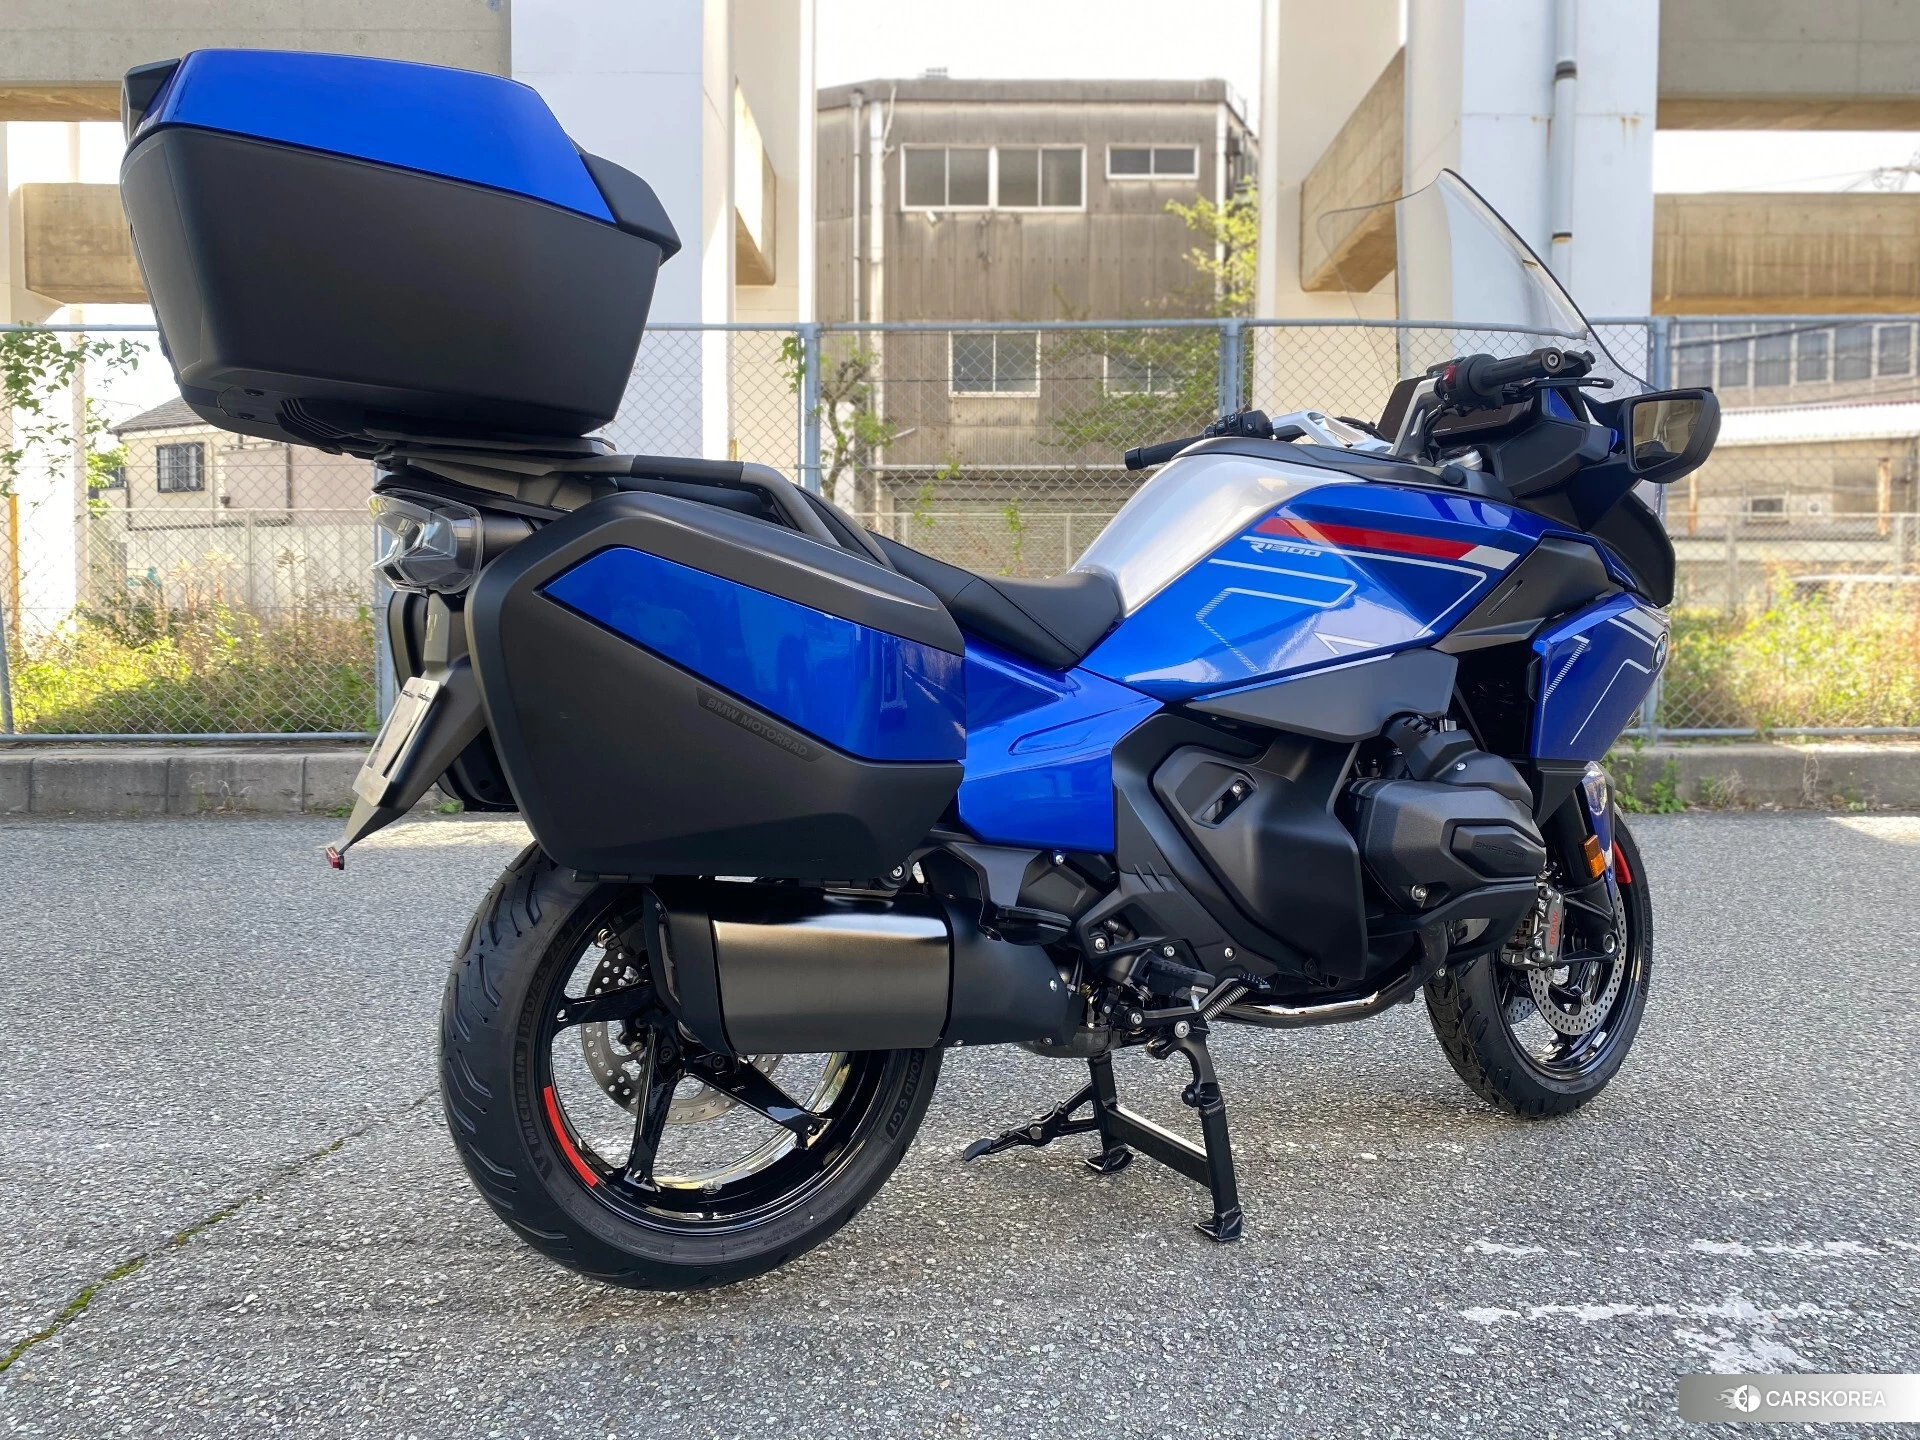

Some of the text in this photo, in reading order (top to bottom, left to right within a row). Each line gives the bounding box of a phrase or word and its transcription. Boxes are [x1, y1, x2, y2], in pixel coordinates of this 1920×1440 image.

[706, 697, 808, 756] BMW MOTORRAD
[1549, 910, 1559, 945] BMW
[519, 965, 548, 1034] 190/55
[515, 1049, 539, 1145] MICHELIN
[904, 1049, 924, 1097] ROAD
[889, 1112, 903, 1136] GT
